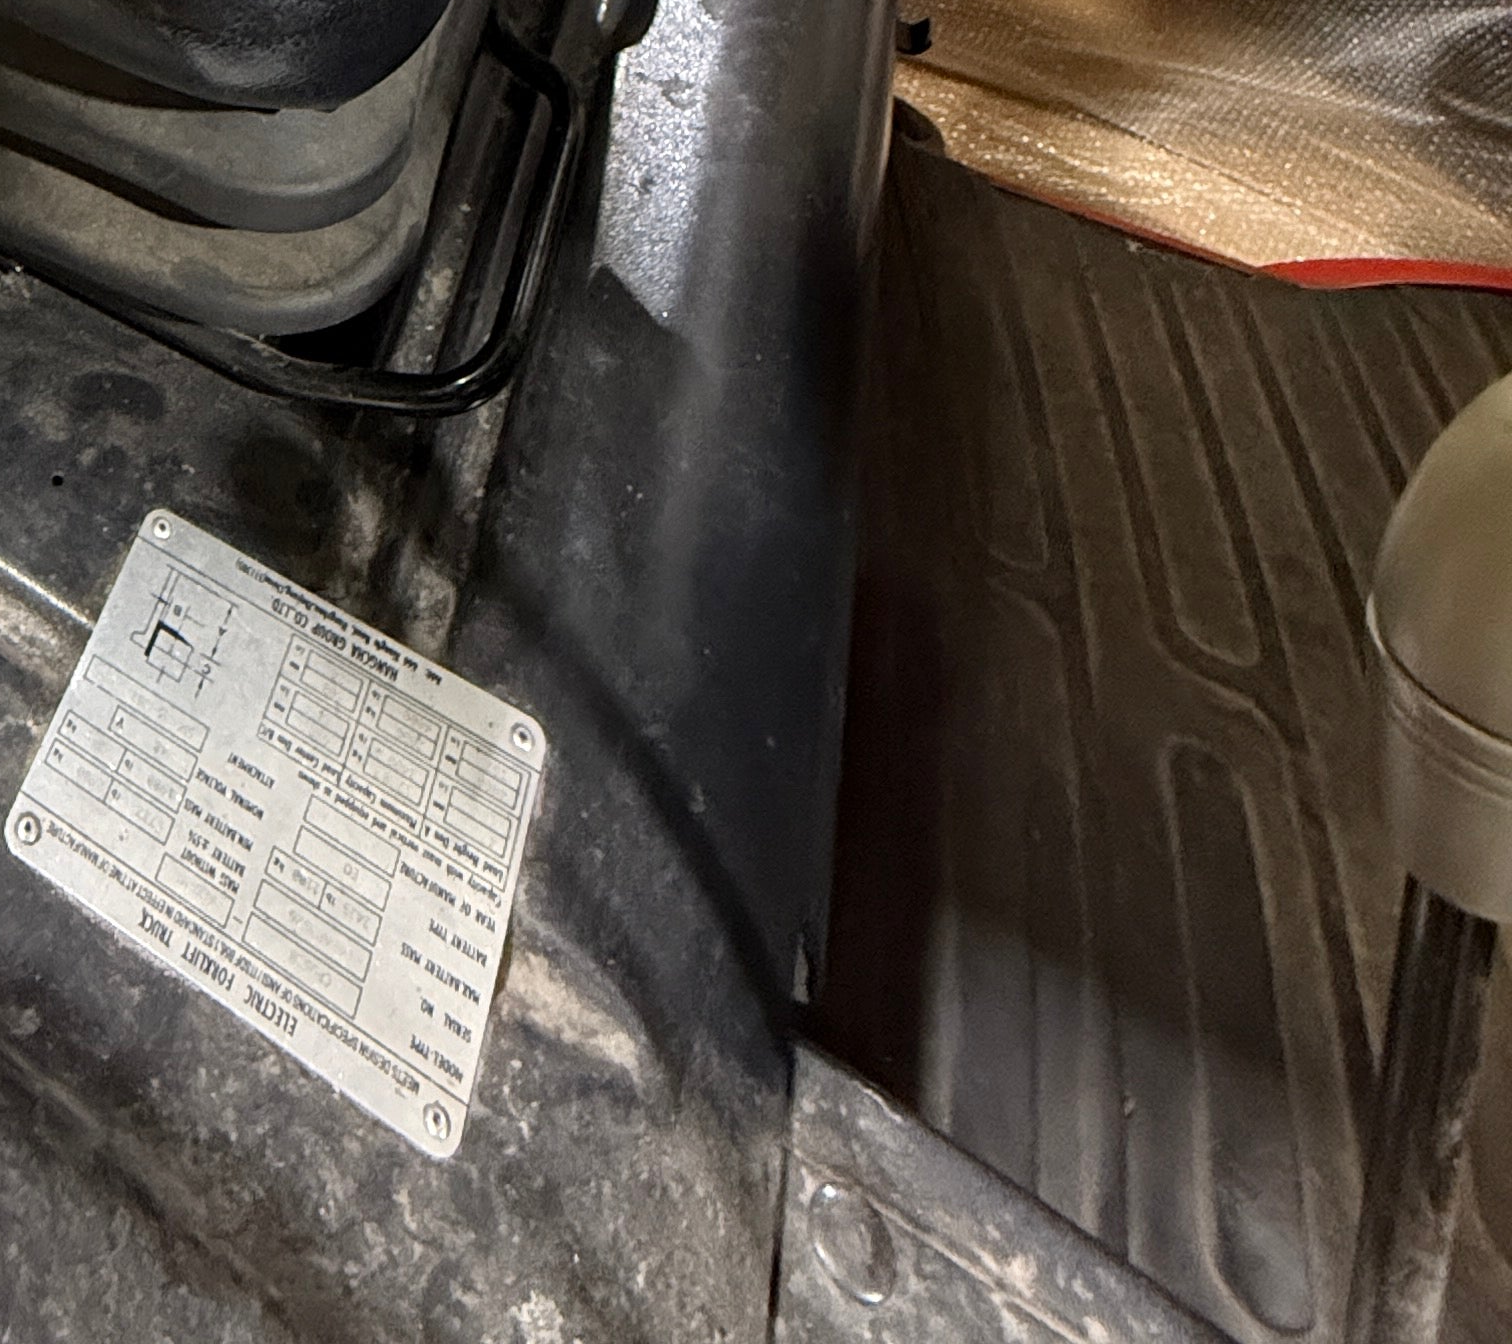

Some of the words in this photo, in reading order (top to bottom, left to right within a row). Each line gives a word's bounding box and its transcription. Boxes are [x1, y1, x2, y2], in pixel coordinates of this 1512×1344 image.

[308, 619, 348, 653] GROUP
[134, 906, 175, 949] TRUCK
[179, 939, 236, 994] FORKLIFT
[240, 982, 299, 1039] ELECTRIC
[289, 991, 360, 1052] SPECIFICATIONS
